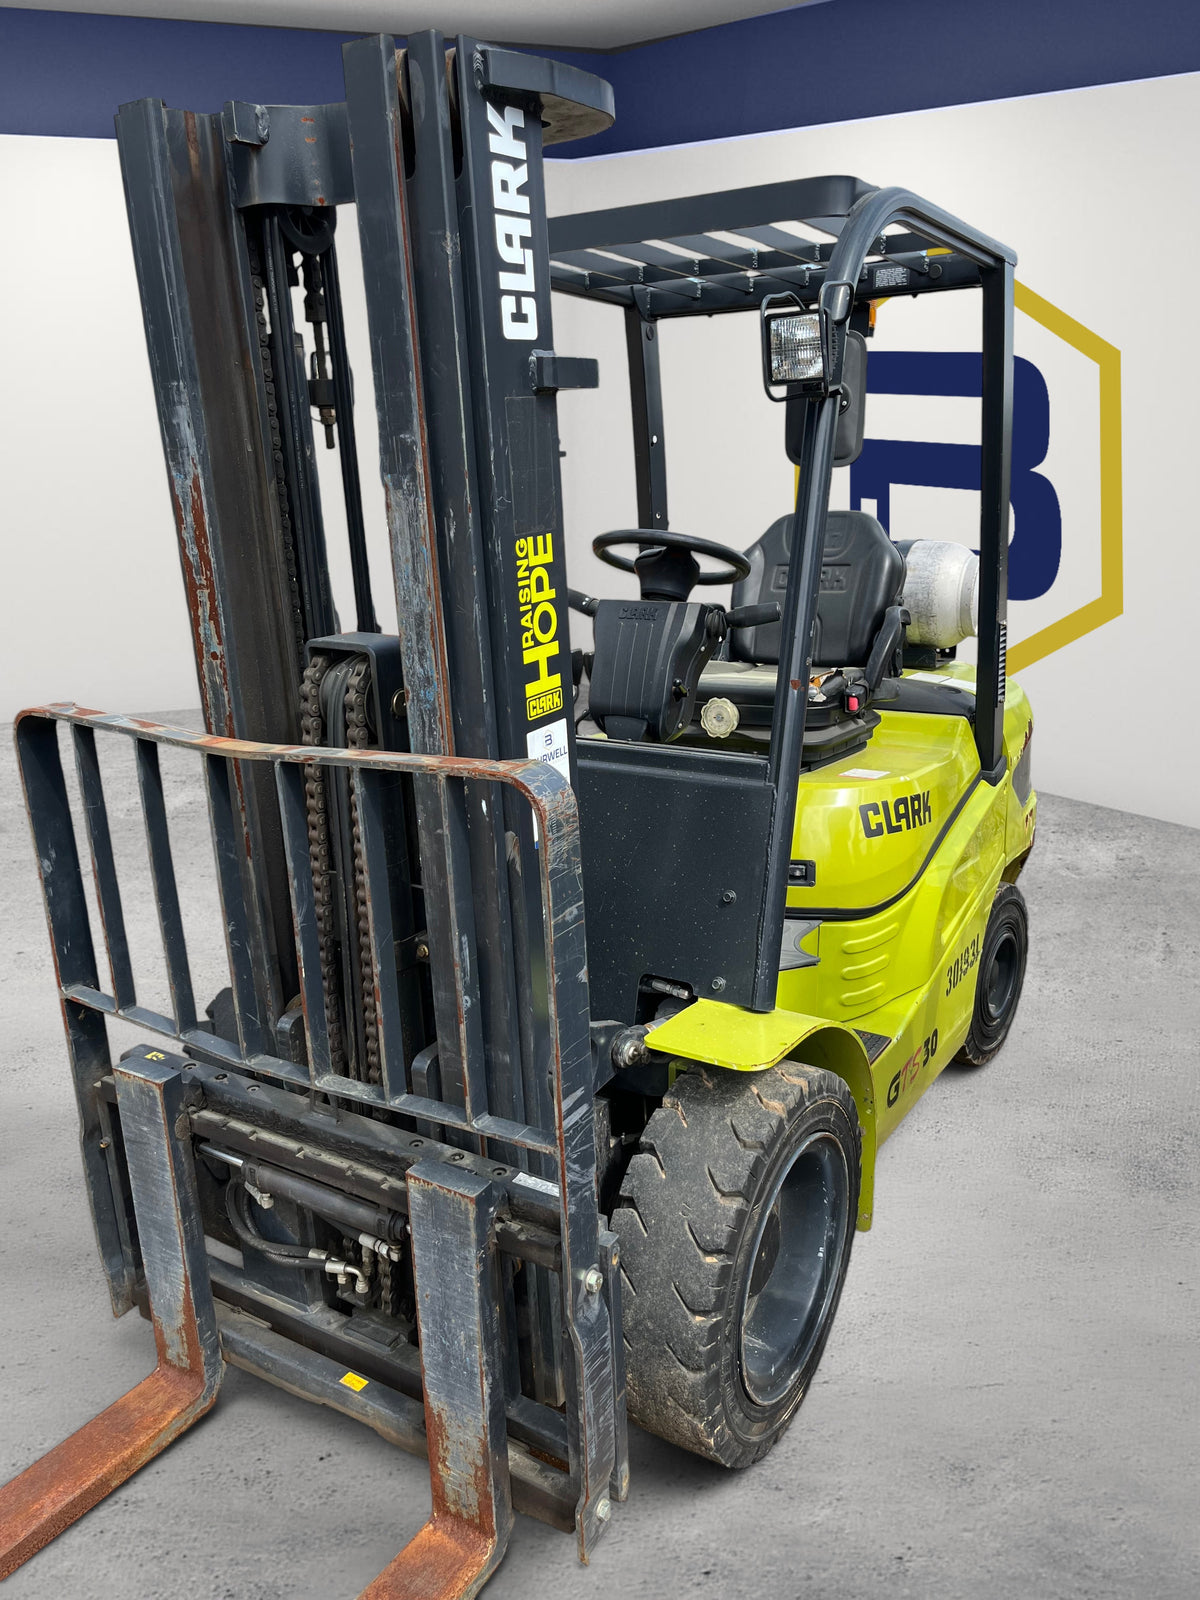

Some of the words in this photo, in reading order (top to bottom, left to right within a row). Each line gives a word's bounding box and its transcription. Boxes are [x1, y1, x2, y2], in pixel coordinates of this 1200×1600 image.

[486, 101, 538, 341] CLARK
[515, 537, 535, 649] RAISING
[523, 532, 562, 698] HOPE
[529, 690, 561, 717] CLARK
[858, 790, 932, 838] CLARK
